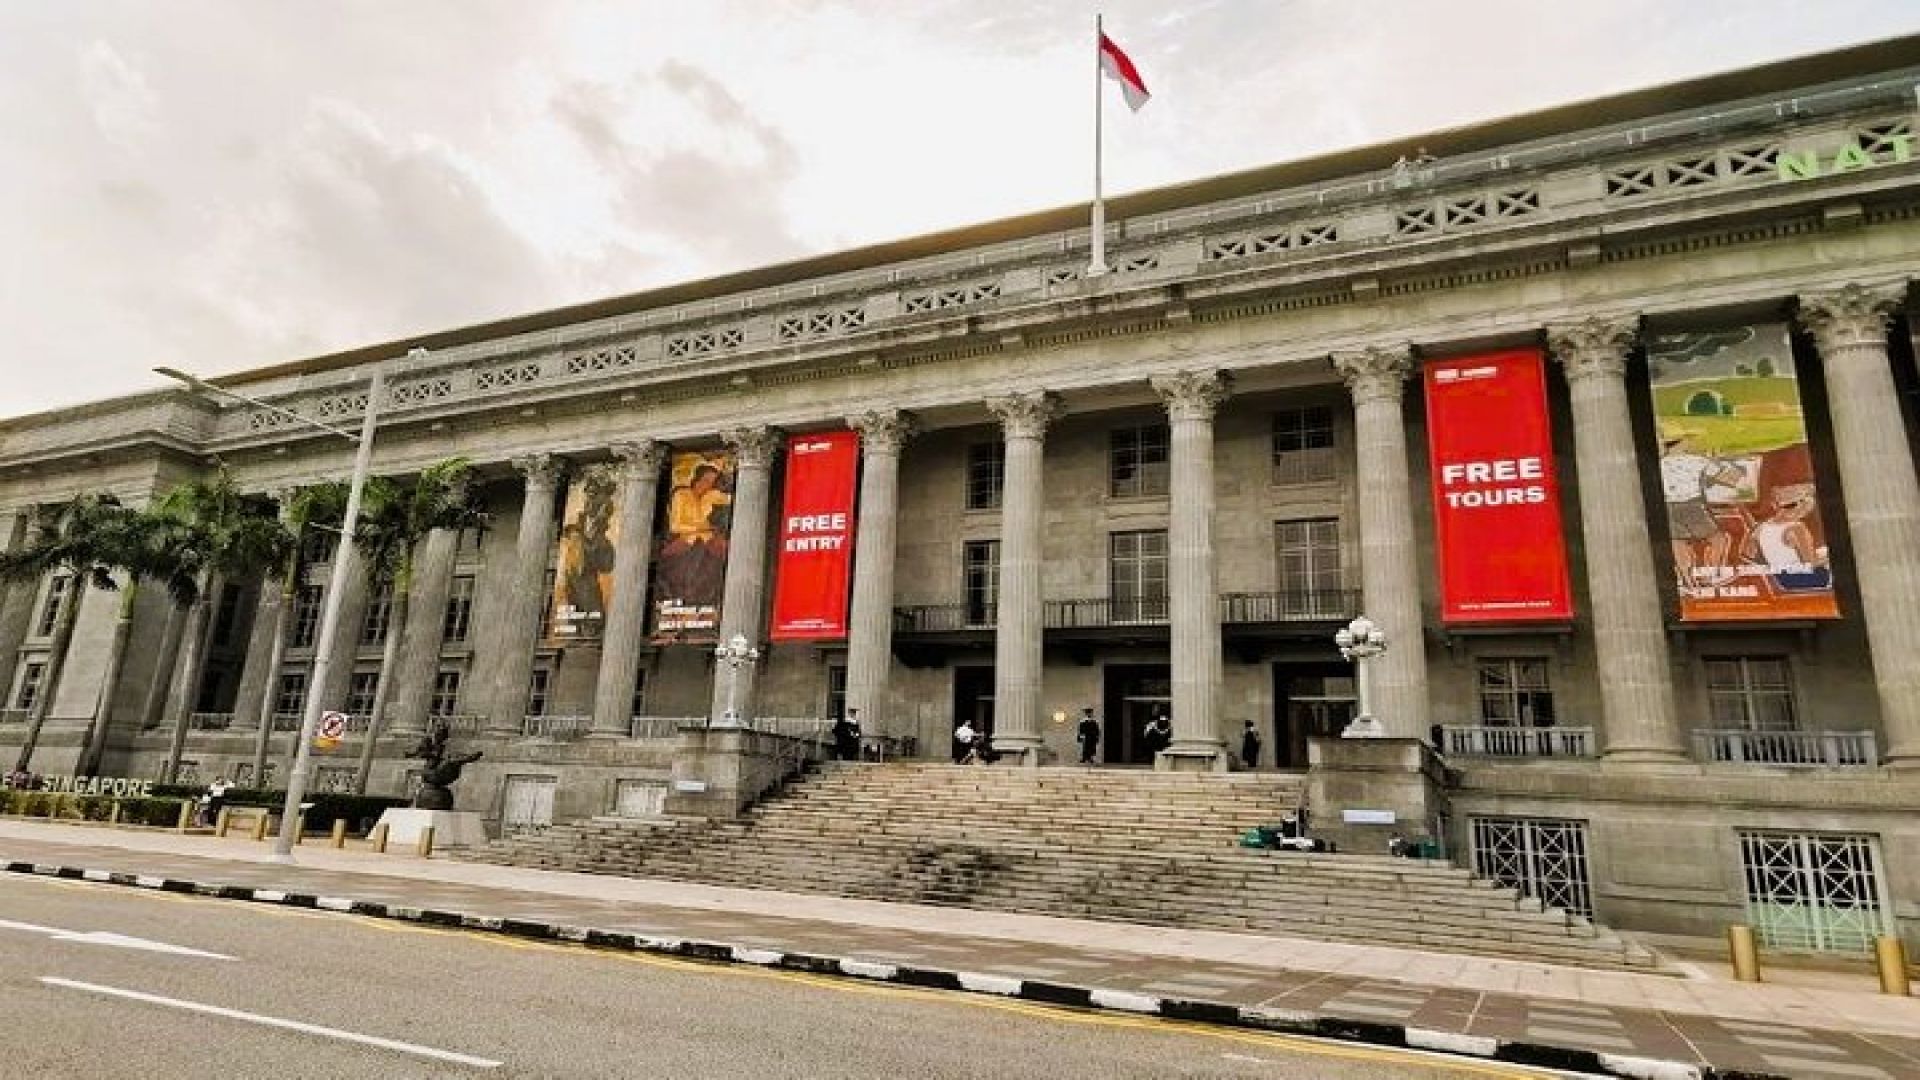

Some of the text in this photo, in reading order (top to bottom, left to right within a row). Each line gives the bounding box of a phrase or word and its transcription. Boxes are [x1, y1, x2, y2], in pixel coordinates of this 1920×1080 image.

[1442, 457, 1544, 485] FREE
[1444, 486, 1545, 509] TOURS
[787, 512, 847, 534] FREE
[784, 534, 846, 553] ENTRY
[41, 774, 153, 798] SINGAPORE
